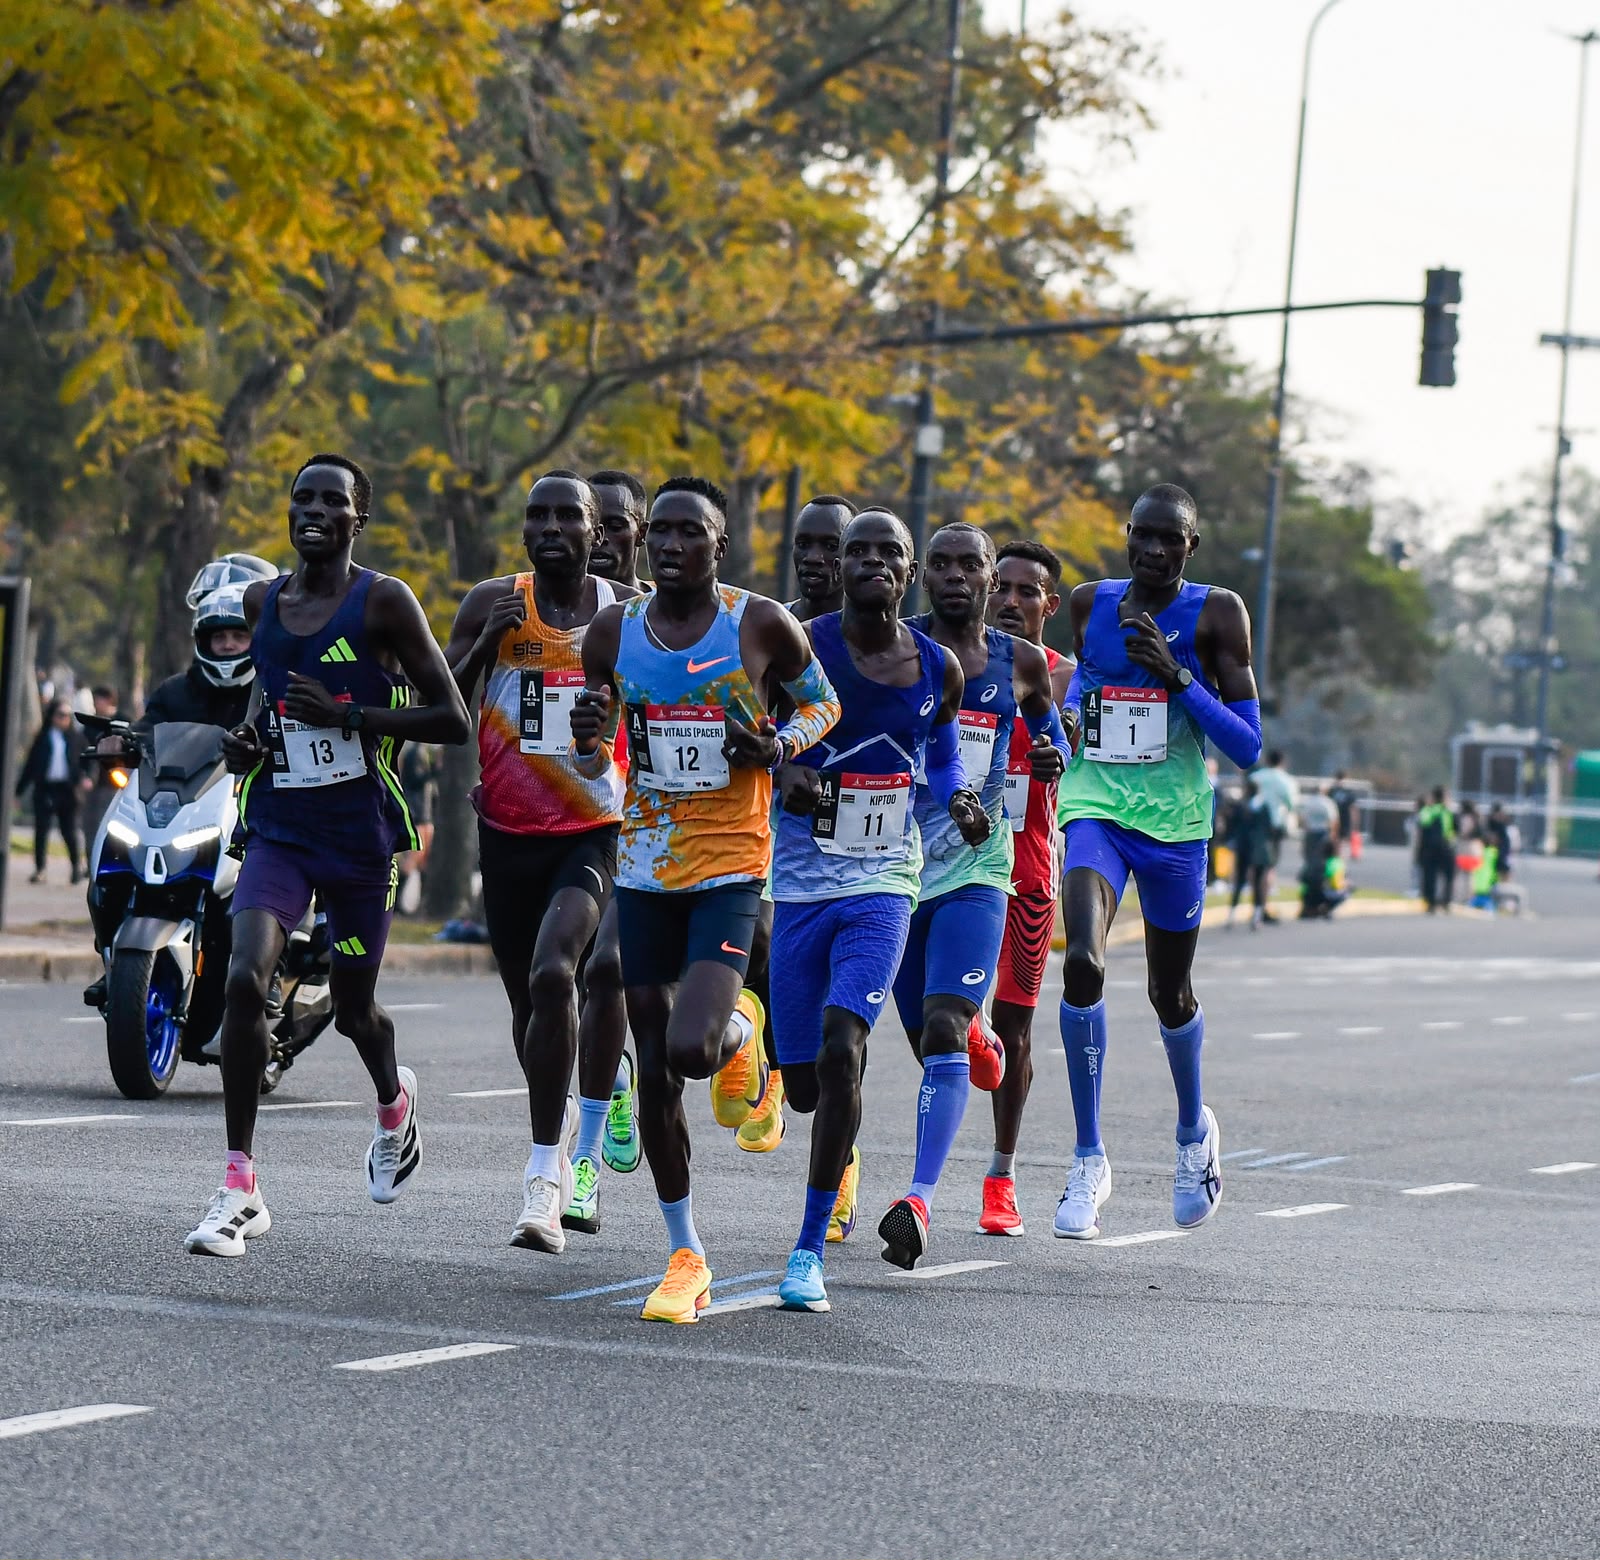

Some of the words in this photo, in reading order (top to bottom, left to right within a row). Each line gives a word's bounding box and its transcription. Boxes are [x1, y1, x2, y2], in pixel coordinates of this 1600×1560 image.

[527, 680, 536, 697] A
[1089, 693, 1096, 709] A
[269, 710, 277, 728] A
[670, 709, 698, 717] personal
[1129, 706, 1150, 717] KIBET
[633, 713, 642, 730] A
[663, 727, 692, 738] VITALIS
[958, 729, 991, 744] IZIMANA
[1128, 723, 1136, 746] 1
[308, 739, 335, 766] 13
[675, 746, 700, 771] 12
[823, 781, 832, 797] A
[1005, 779, 1017, 789] OM
[869, 794, 896, 806] KIPTOO
[864, 813, 884, 836] 11
